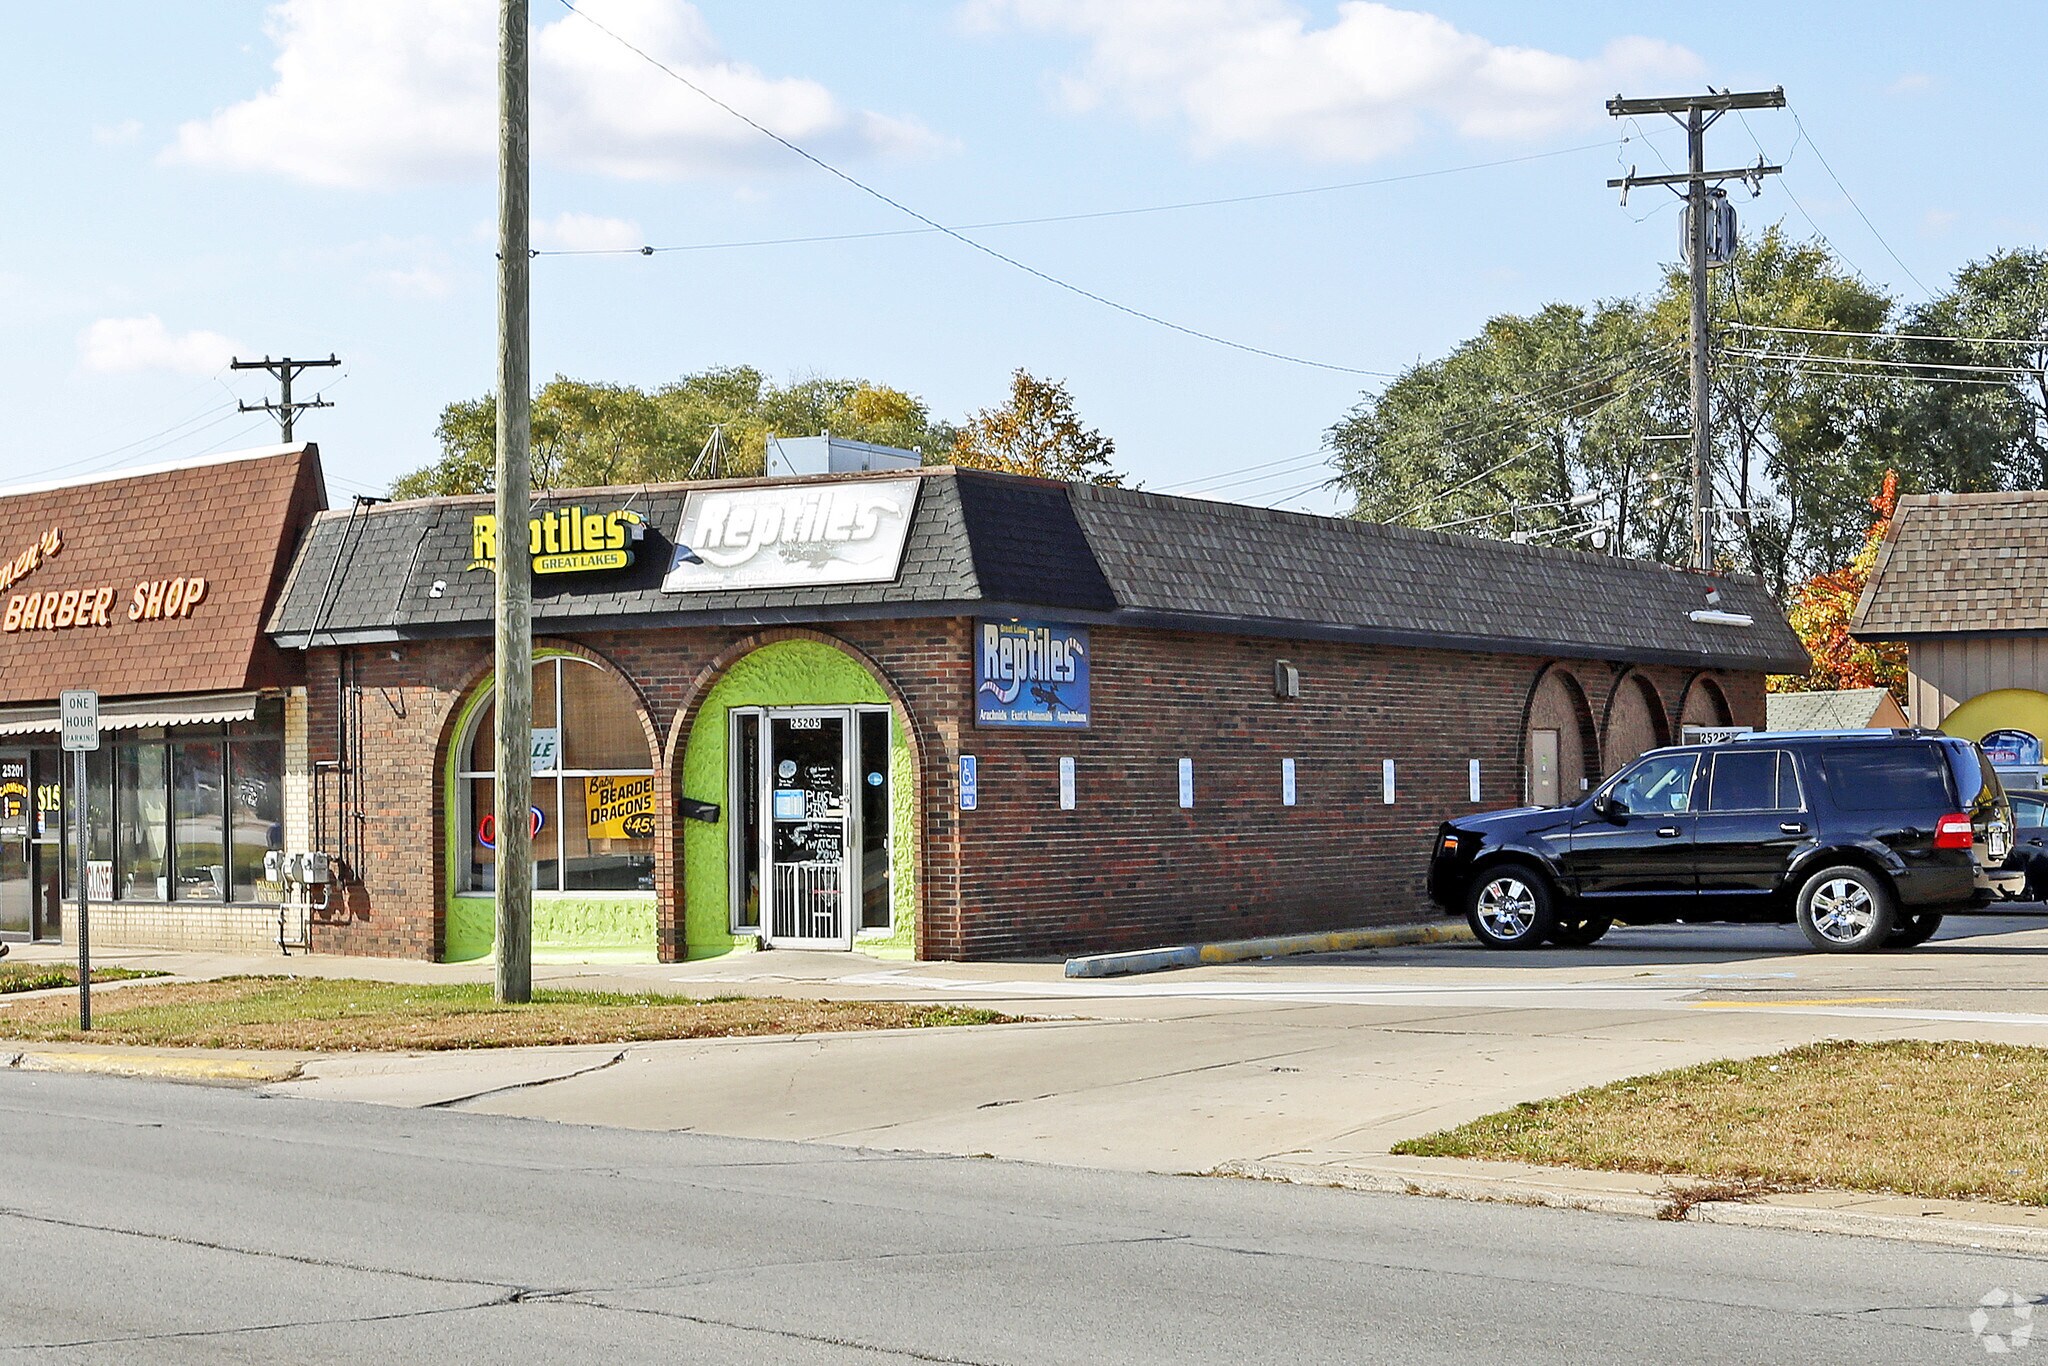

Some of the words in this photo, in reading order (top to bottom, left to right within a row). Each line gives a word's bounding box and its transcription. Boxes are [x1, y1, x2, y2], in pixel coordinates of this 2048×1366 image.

[692, 491, 903, 568] Reptiles
[467, 506, 641, 571] Rptiles
[541, 557, 579, 570] GREAT
[582, 553, 619, 566] LAKES
[2, 586, 114, 631] BARBER
[127, 576, 208, 622] SHOP
[979, 624, 1084, 704] Reptiles
[69, 698, 89, 709] ONE
[66, 716, 94, 727] HOUR
[791, 718, 821, 728] 25205
[980, 709, 1007, 721] Arachnids
[66, 734, 95, 742] PARKING
[2, 764, 24, 778] 25201
[589, 776, 615, 795] Baby
[590, 794, 652, 826] DRAGONS
